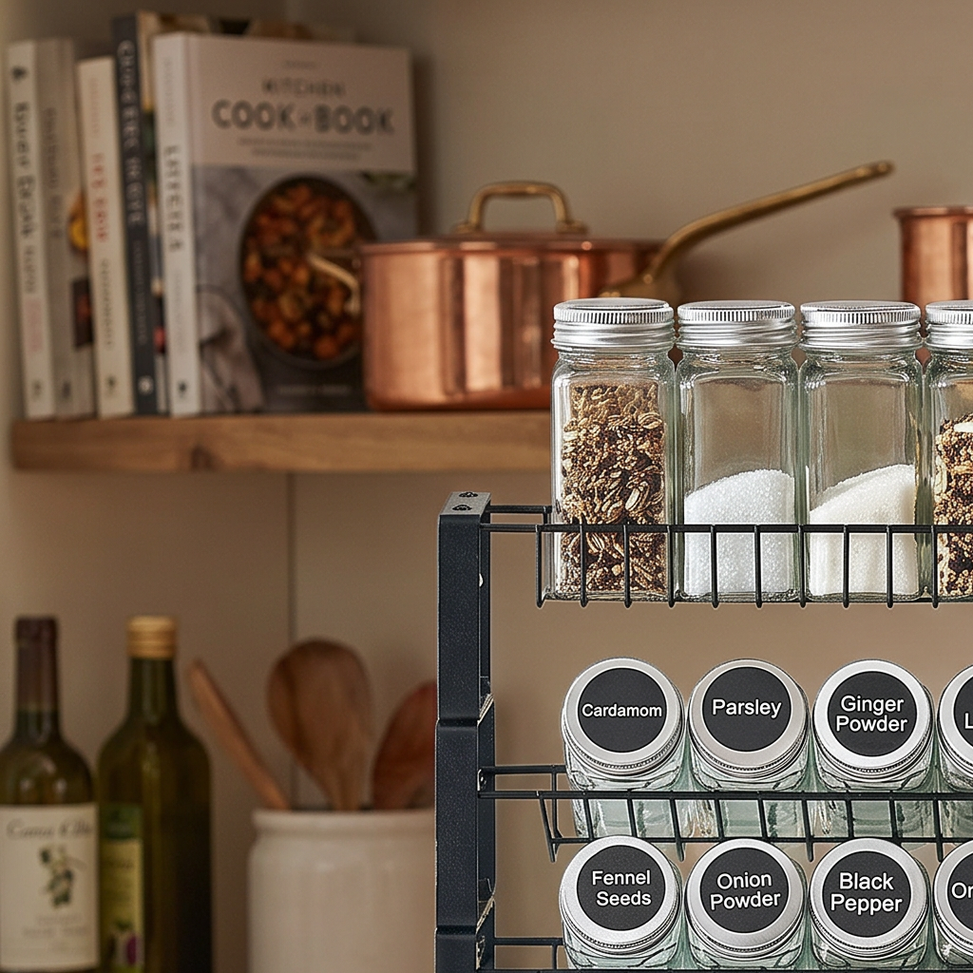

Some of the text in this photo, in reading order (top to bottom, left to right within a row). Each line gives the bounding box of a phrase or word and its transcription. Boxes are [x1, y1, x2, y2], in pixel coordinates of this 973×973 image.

[581, 703, 662, 717] Cardamom
[712, 698, 782, 719] Parsley
[840, 695, 905, 716] Ginger
[836, 714, 908, 732] Powder
[592, 869, 651, 886] Fennel
[717, 873, 772, 890] Onion
[839, 872, 894, 890] Black
[596, 890, 652, 907] Seeds
[710, 890, 781, 911] Powder
[830, 893, 903, 916] Pepper
